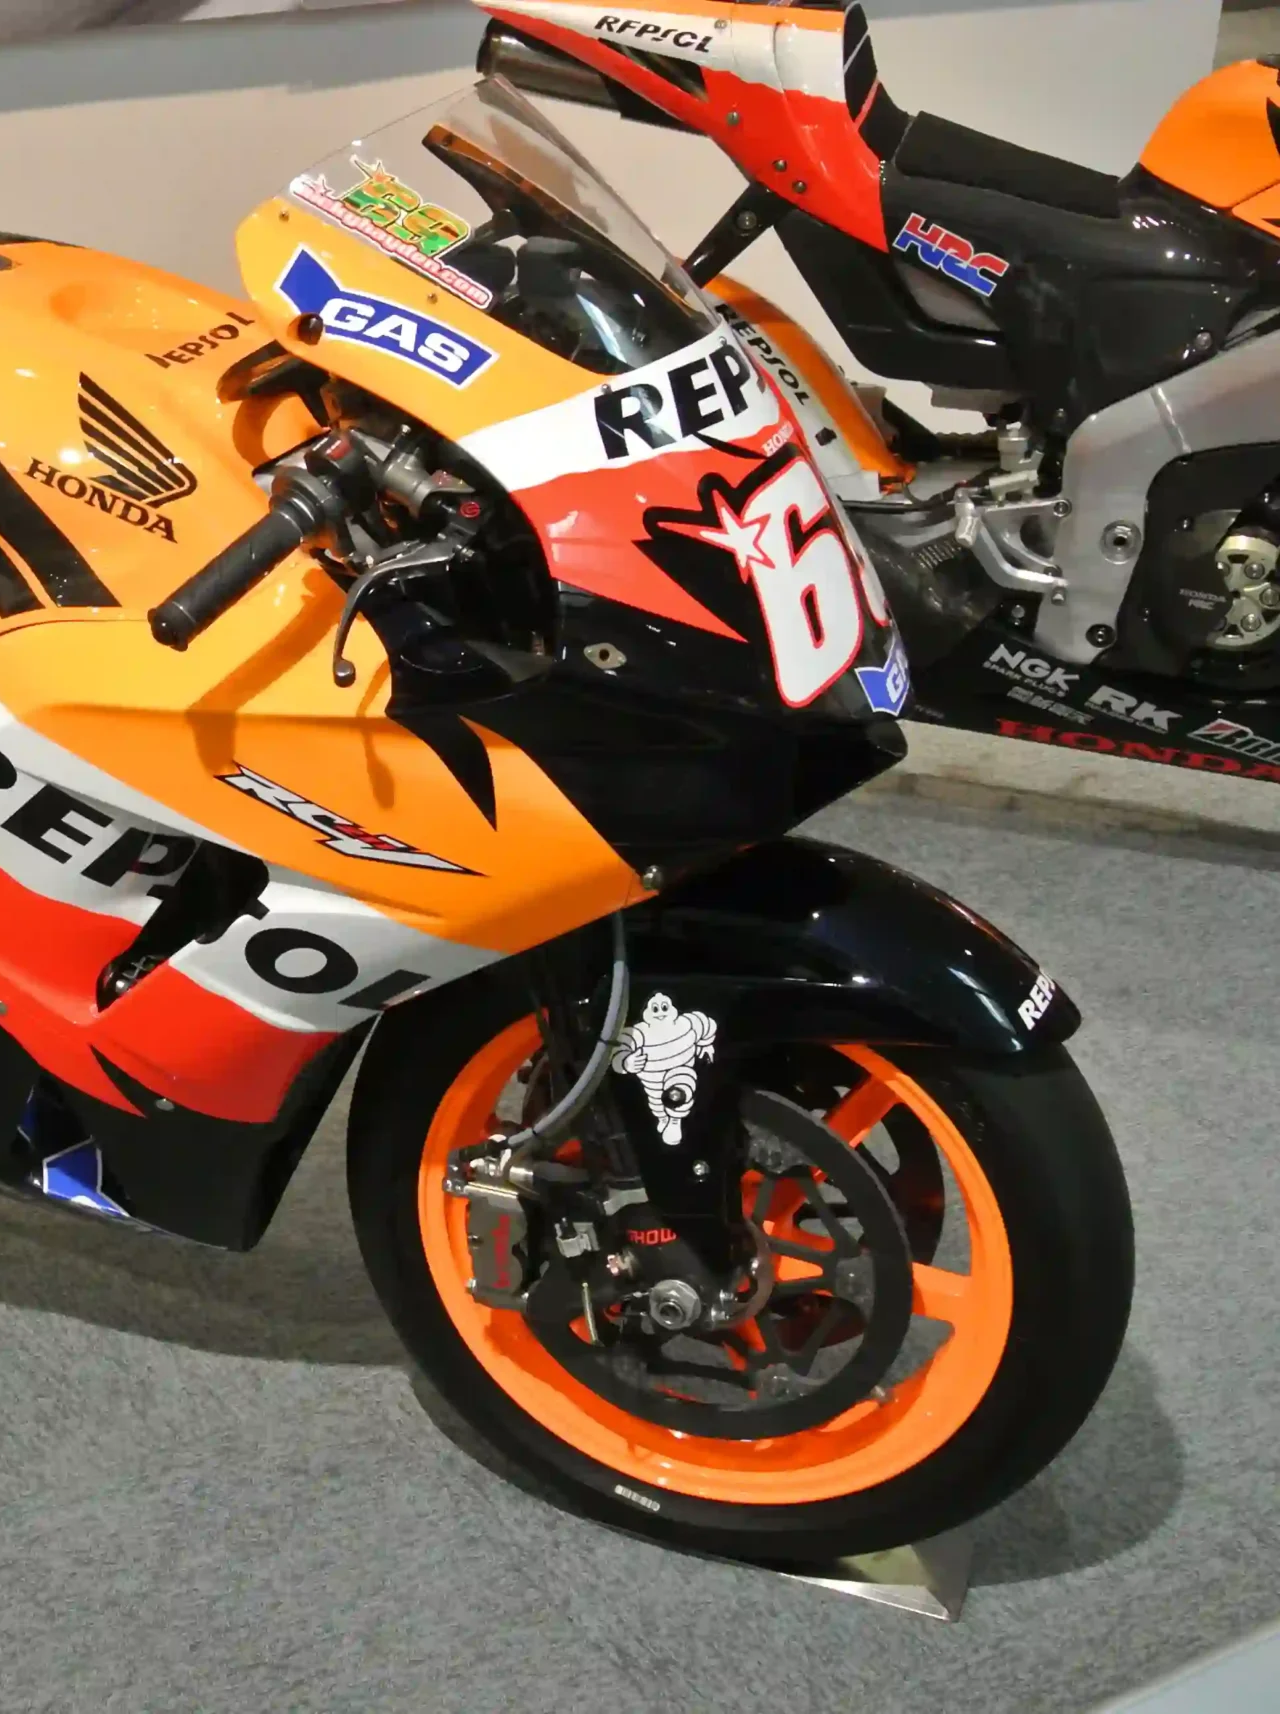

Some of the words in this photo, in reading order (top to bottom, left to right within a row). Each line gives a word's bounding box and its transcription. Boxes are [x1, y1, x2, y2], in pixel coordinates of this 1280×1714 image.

[320, 297, 477, 374] GAS
[715, 303, 811, 406] REPSOL
[594, 345, 756, 461] REP
[24, 456, 178, 544] HONDA
[739, 456, 892, 709] 6
[989, 643, 1081, 692] NGK
[1085, 685, 1184, 732] RK
